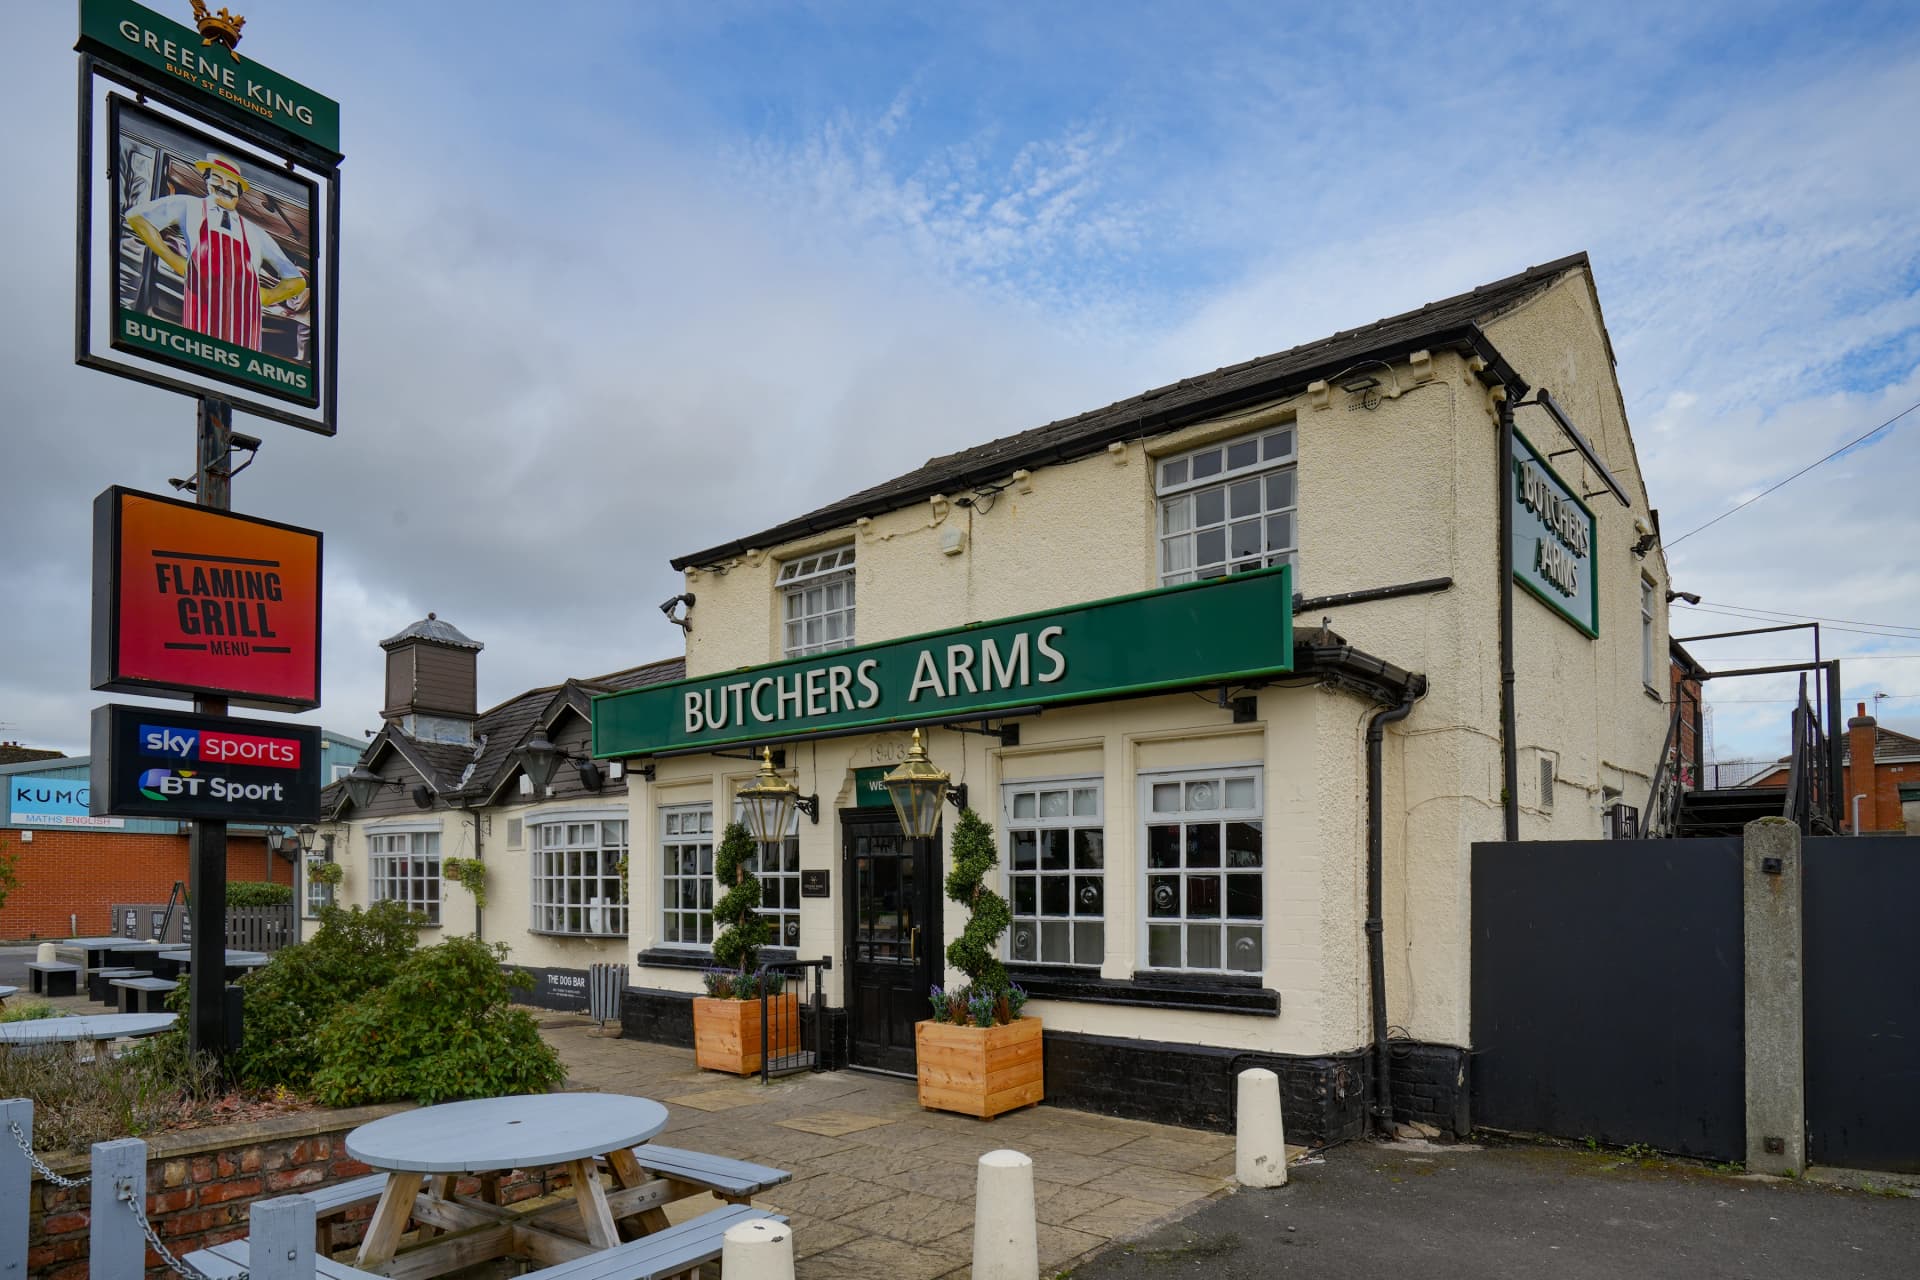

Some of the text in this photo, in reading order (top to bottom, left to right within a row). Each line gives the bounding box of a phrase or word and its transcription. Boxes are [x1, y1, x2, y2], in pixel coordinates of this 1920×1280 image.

[119, 20, 313, 126] GREENE KING
[166, 63, 273, 119] BURY ST EDMUNDS
[125, 319, 307, 389] BUTCHERS ARMS
[1522, 460, 1589, 558] BUTCHERS
[155, 562, 283, 602] FLAMING
[1540, 536, 1578, 598] ARMS
[177, 597, 276, 638] GRILL
[210, 640, 251, 656] MENU
[684, 625, 1067, 734] BUTCHERS ARMS
[146, 729, 295, 762] sky sports
[17, 788, 90, 808] KUMO
[160, 776, 284, 802] BT Sport
[26, 815, 111, 825] MATHS ENGLISH
[547, 975, 585, 987] THE DOG BAR
